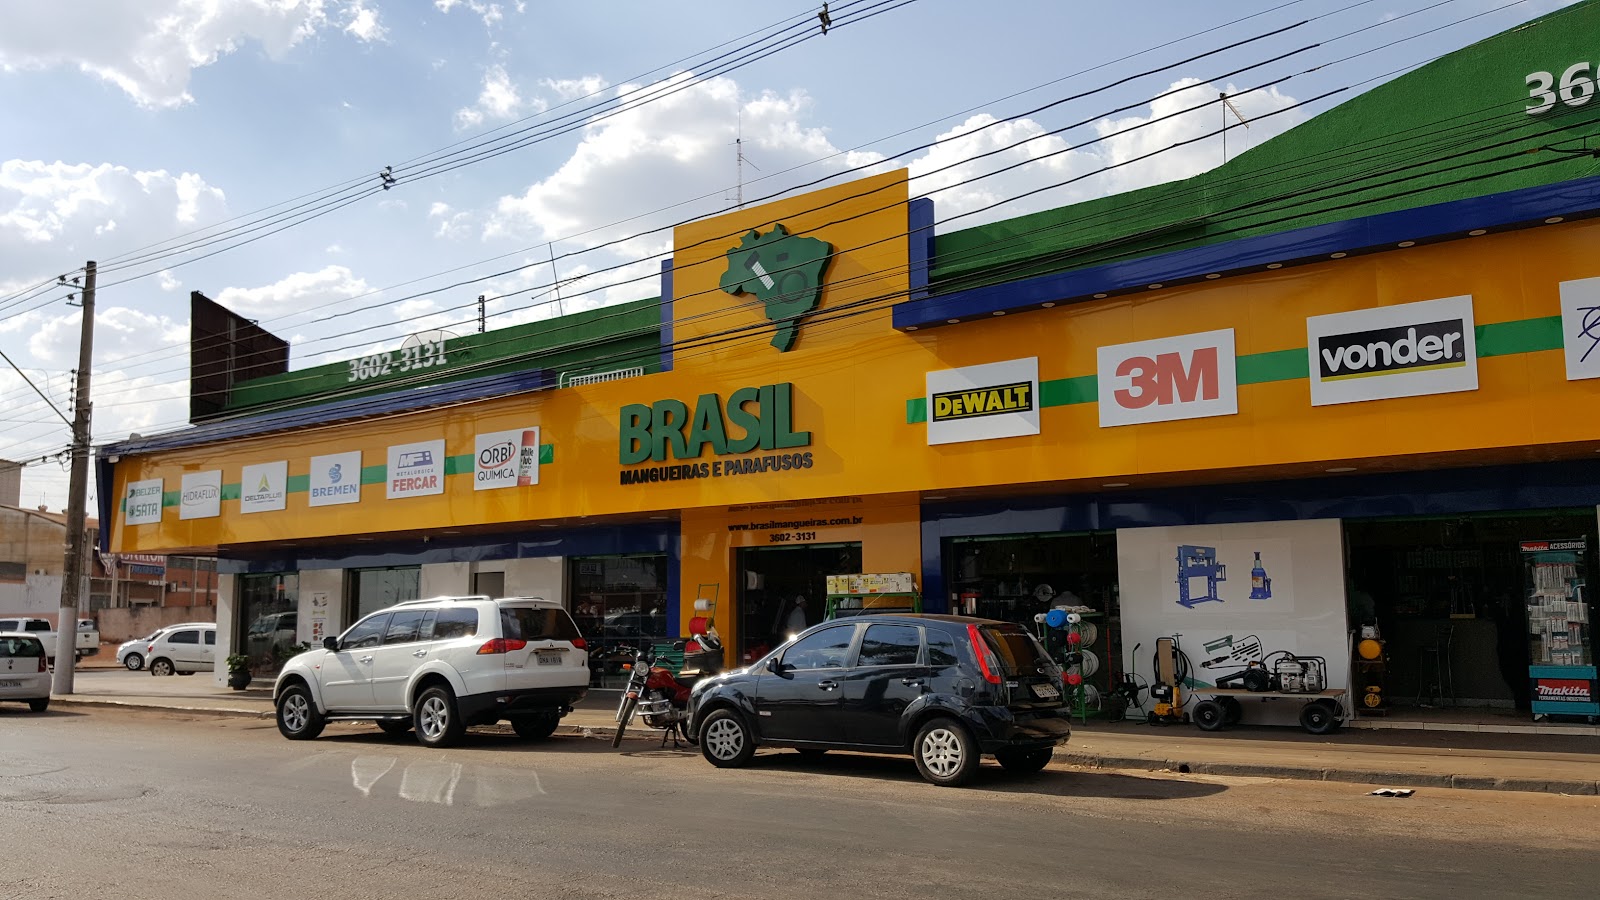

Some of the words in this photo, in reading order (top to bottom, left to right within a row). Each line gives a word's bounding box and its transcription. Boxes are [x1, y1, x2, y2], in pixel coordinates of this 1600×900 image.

[1526, 62, 1600, 115] 36
[348, 341, 447, 382] 3602-3131
[1322, 328, 1462, 372] vonder
[1114, 346, 1219, 409] 3M
[619, 382, 811, 465] BRASIL
[393, 475, 437, 492] FERCAR
[620, 462, 709, 485] MANGUEIRAS
[712, 461, 722, 476] E
[724, 452, 813, 476] PARAFUSOS
[135, 486, 161, 497] BELZER
[312, 484, 357, 498] BREMEN
[728, 516, 863, 532] www.brasilmangueiras.com.br
[1537, 685, 1591, 696] makita
